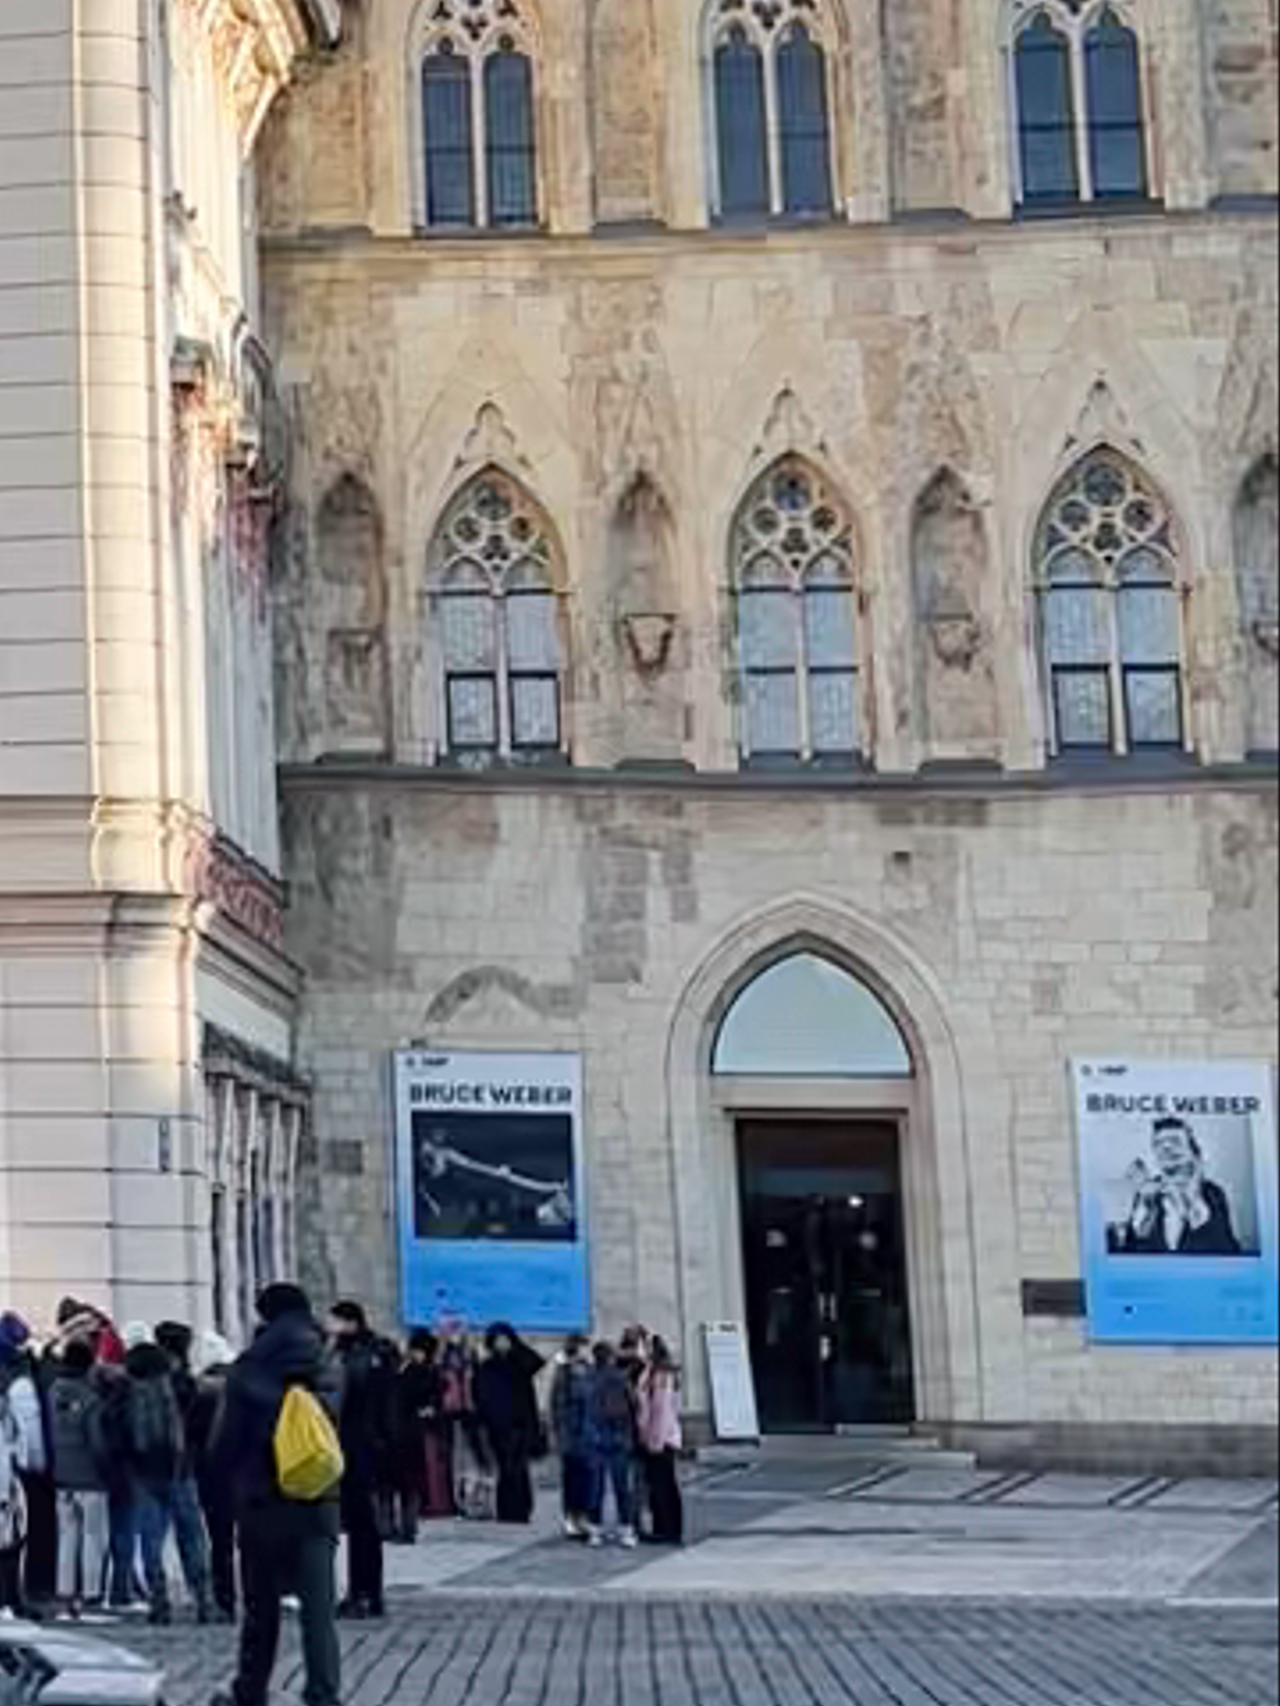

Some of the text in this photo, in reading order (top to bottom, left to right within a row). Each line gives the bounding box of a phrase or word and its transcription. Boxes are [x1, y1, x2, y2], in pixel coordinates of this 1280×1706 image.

[410, 1084, 572, 1104] BRUCE WEBER
[1086, 1093, 1261, 1115] BRUCE WEBER
